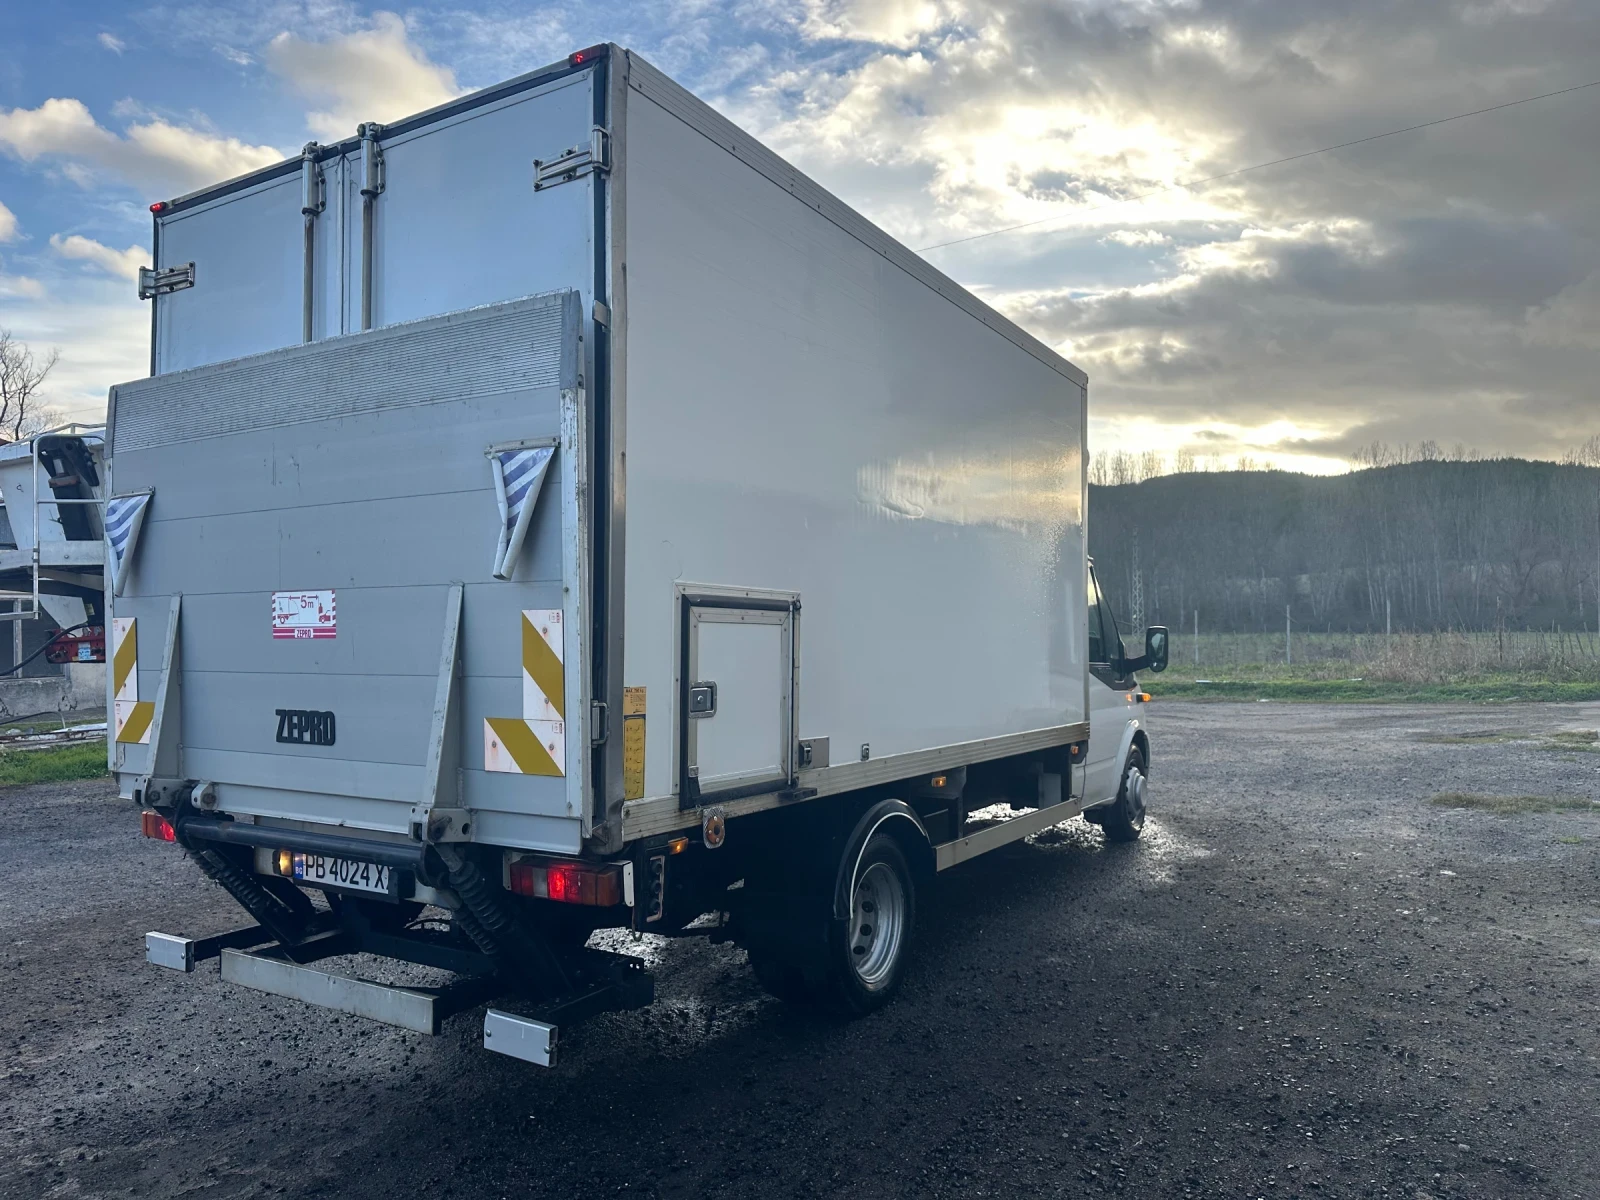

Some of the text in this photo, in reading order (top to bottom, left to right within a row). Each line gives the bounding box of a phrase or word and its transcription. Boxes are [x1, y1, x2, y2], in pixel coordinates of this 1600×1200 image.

[300, 595, 314, 609] 5m
[296, 629, 312, 638] ZEPRO
[275, 709, 336, 746] ZEPRO
[305, 855, 389, 890] PB 4024 X
